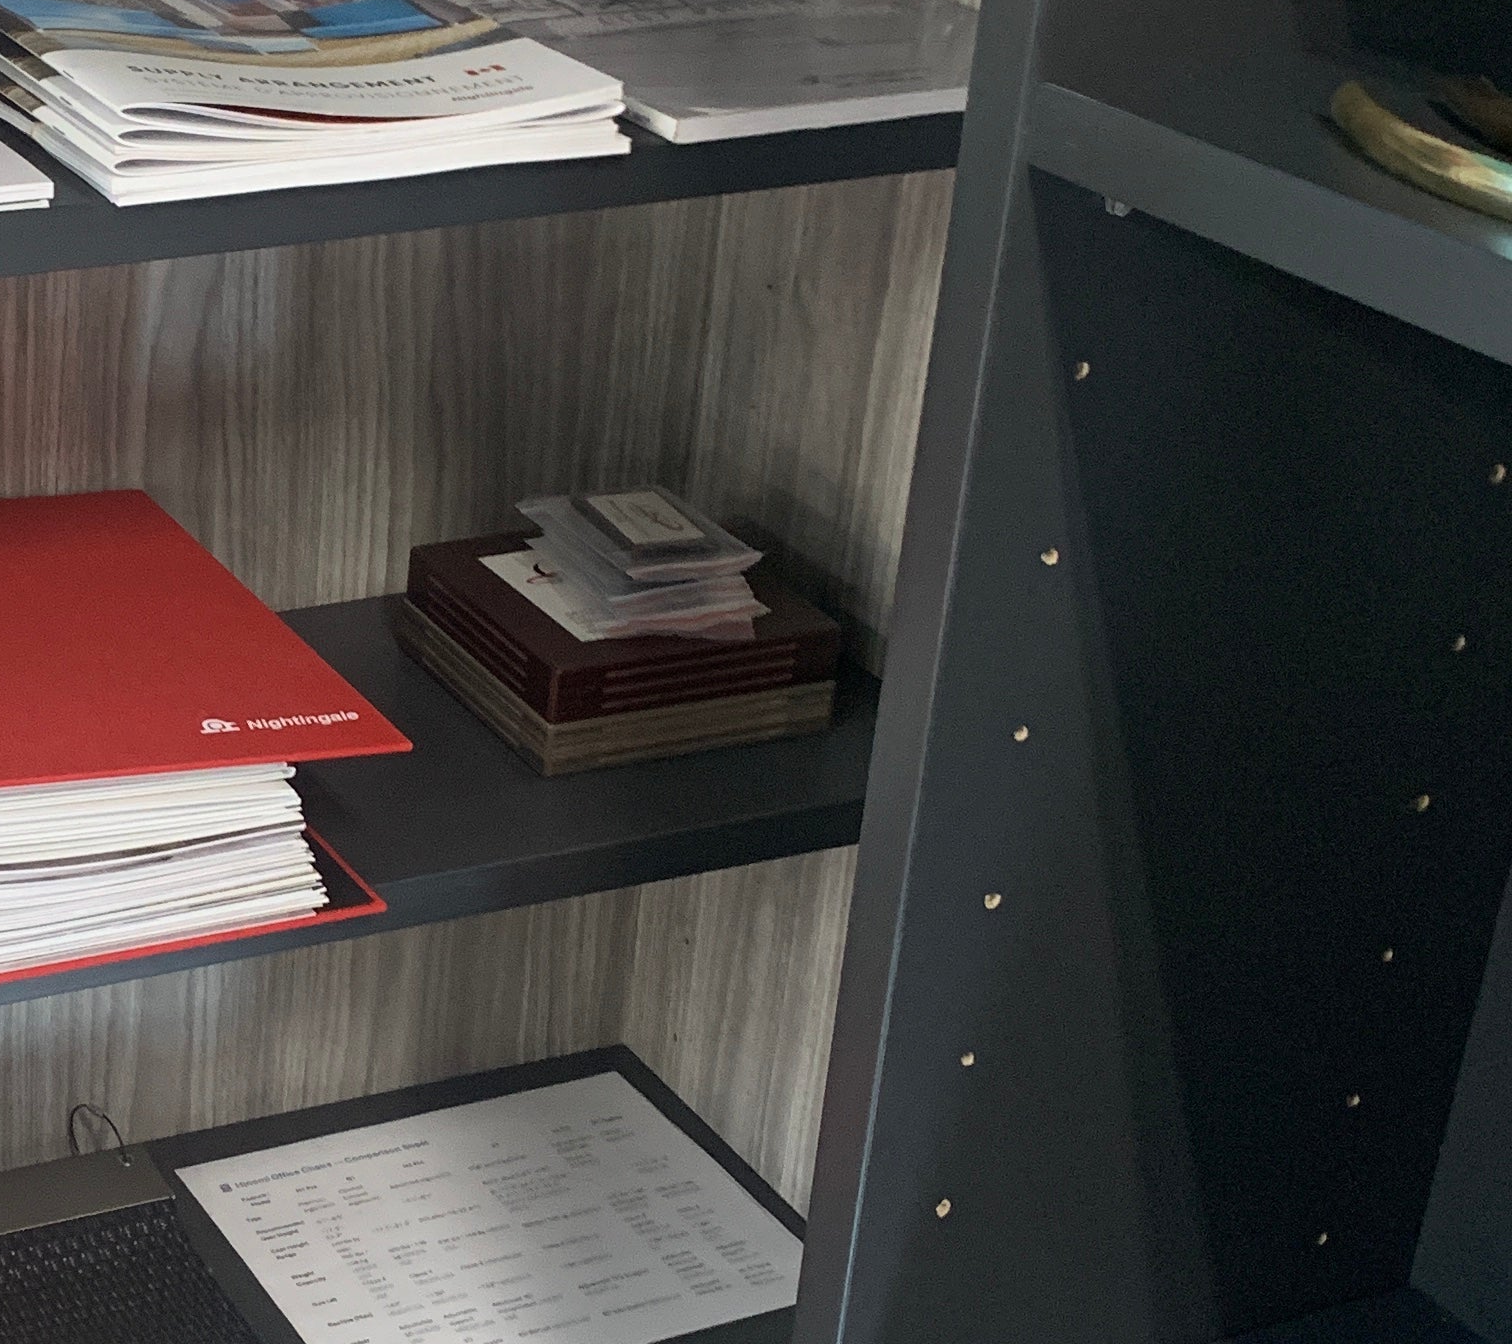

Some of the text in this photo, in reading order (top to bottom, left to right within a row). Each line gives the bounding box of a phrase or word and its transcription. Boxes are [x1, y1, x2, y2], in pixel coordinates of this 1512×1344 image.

[127, 65, 435, 89] SUPPLY ARRANGEMENT
[246, 710, 360, 731] Nightingale
